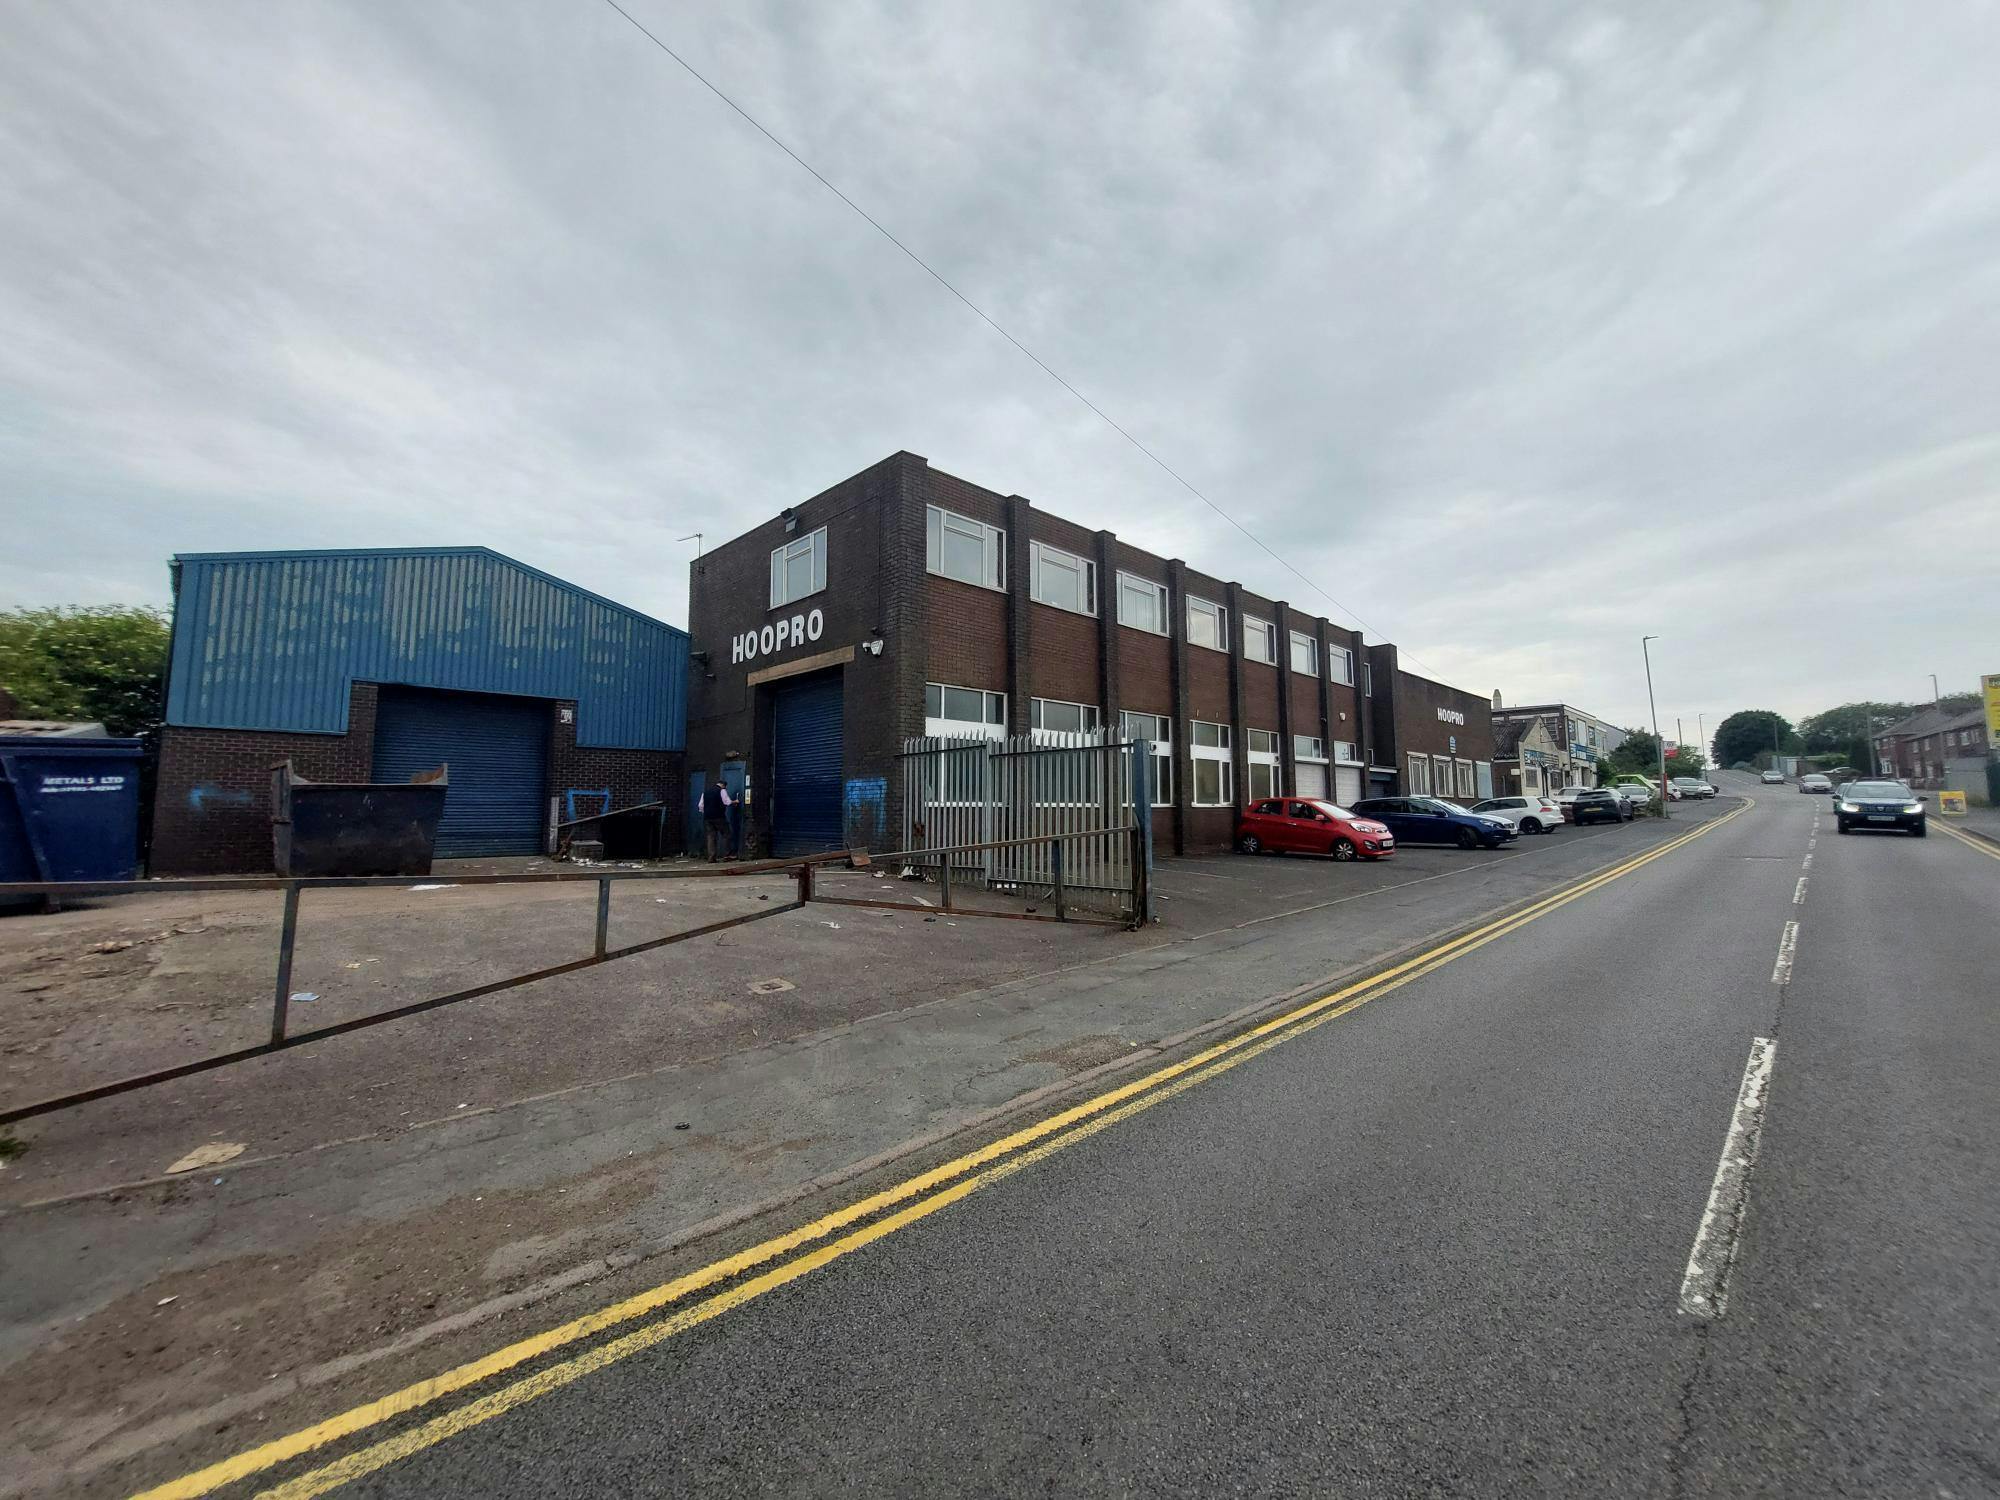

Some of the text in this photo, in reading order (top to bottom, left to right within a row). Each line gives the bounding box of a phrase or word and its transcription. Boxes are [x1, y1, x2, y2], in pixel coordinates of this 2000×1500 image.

[732, 608, 824, 665] HOOPRO
[1437, 707, 1464, 726] HOOPRO
[43, 776, 124, 785] METALS LTD
